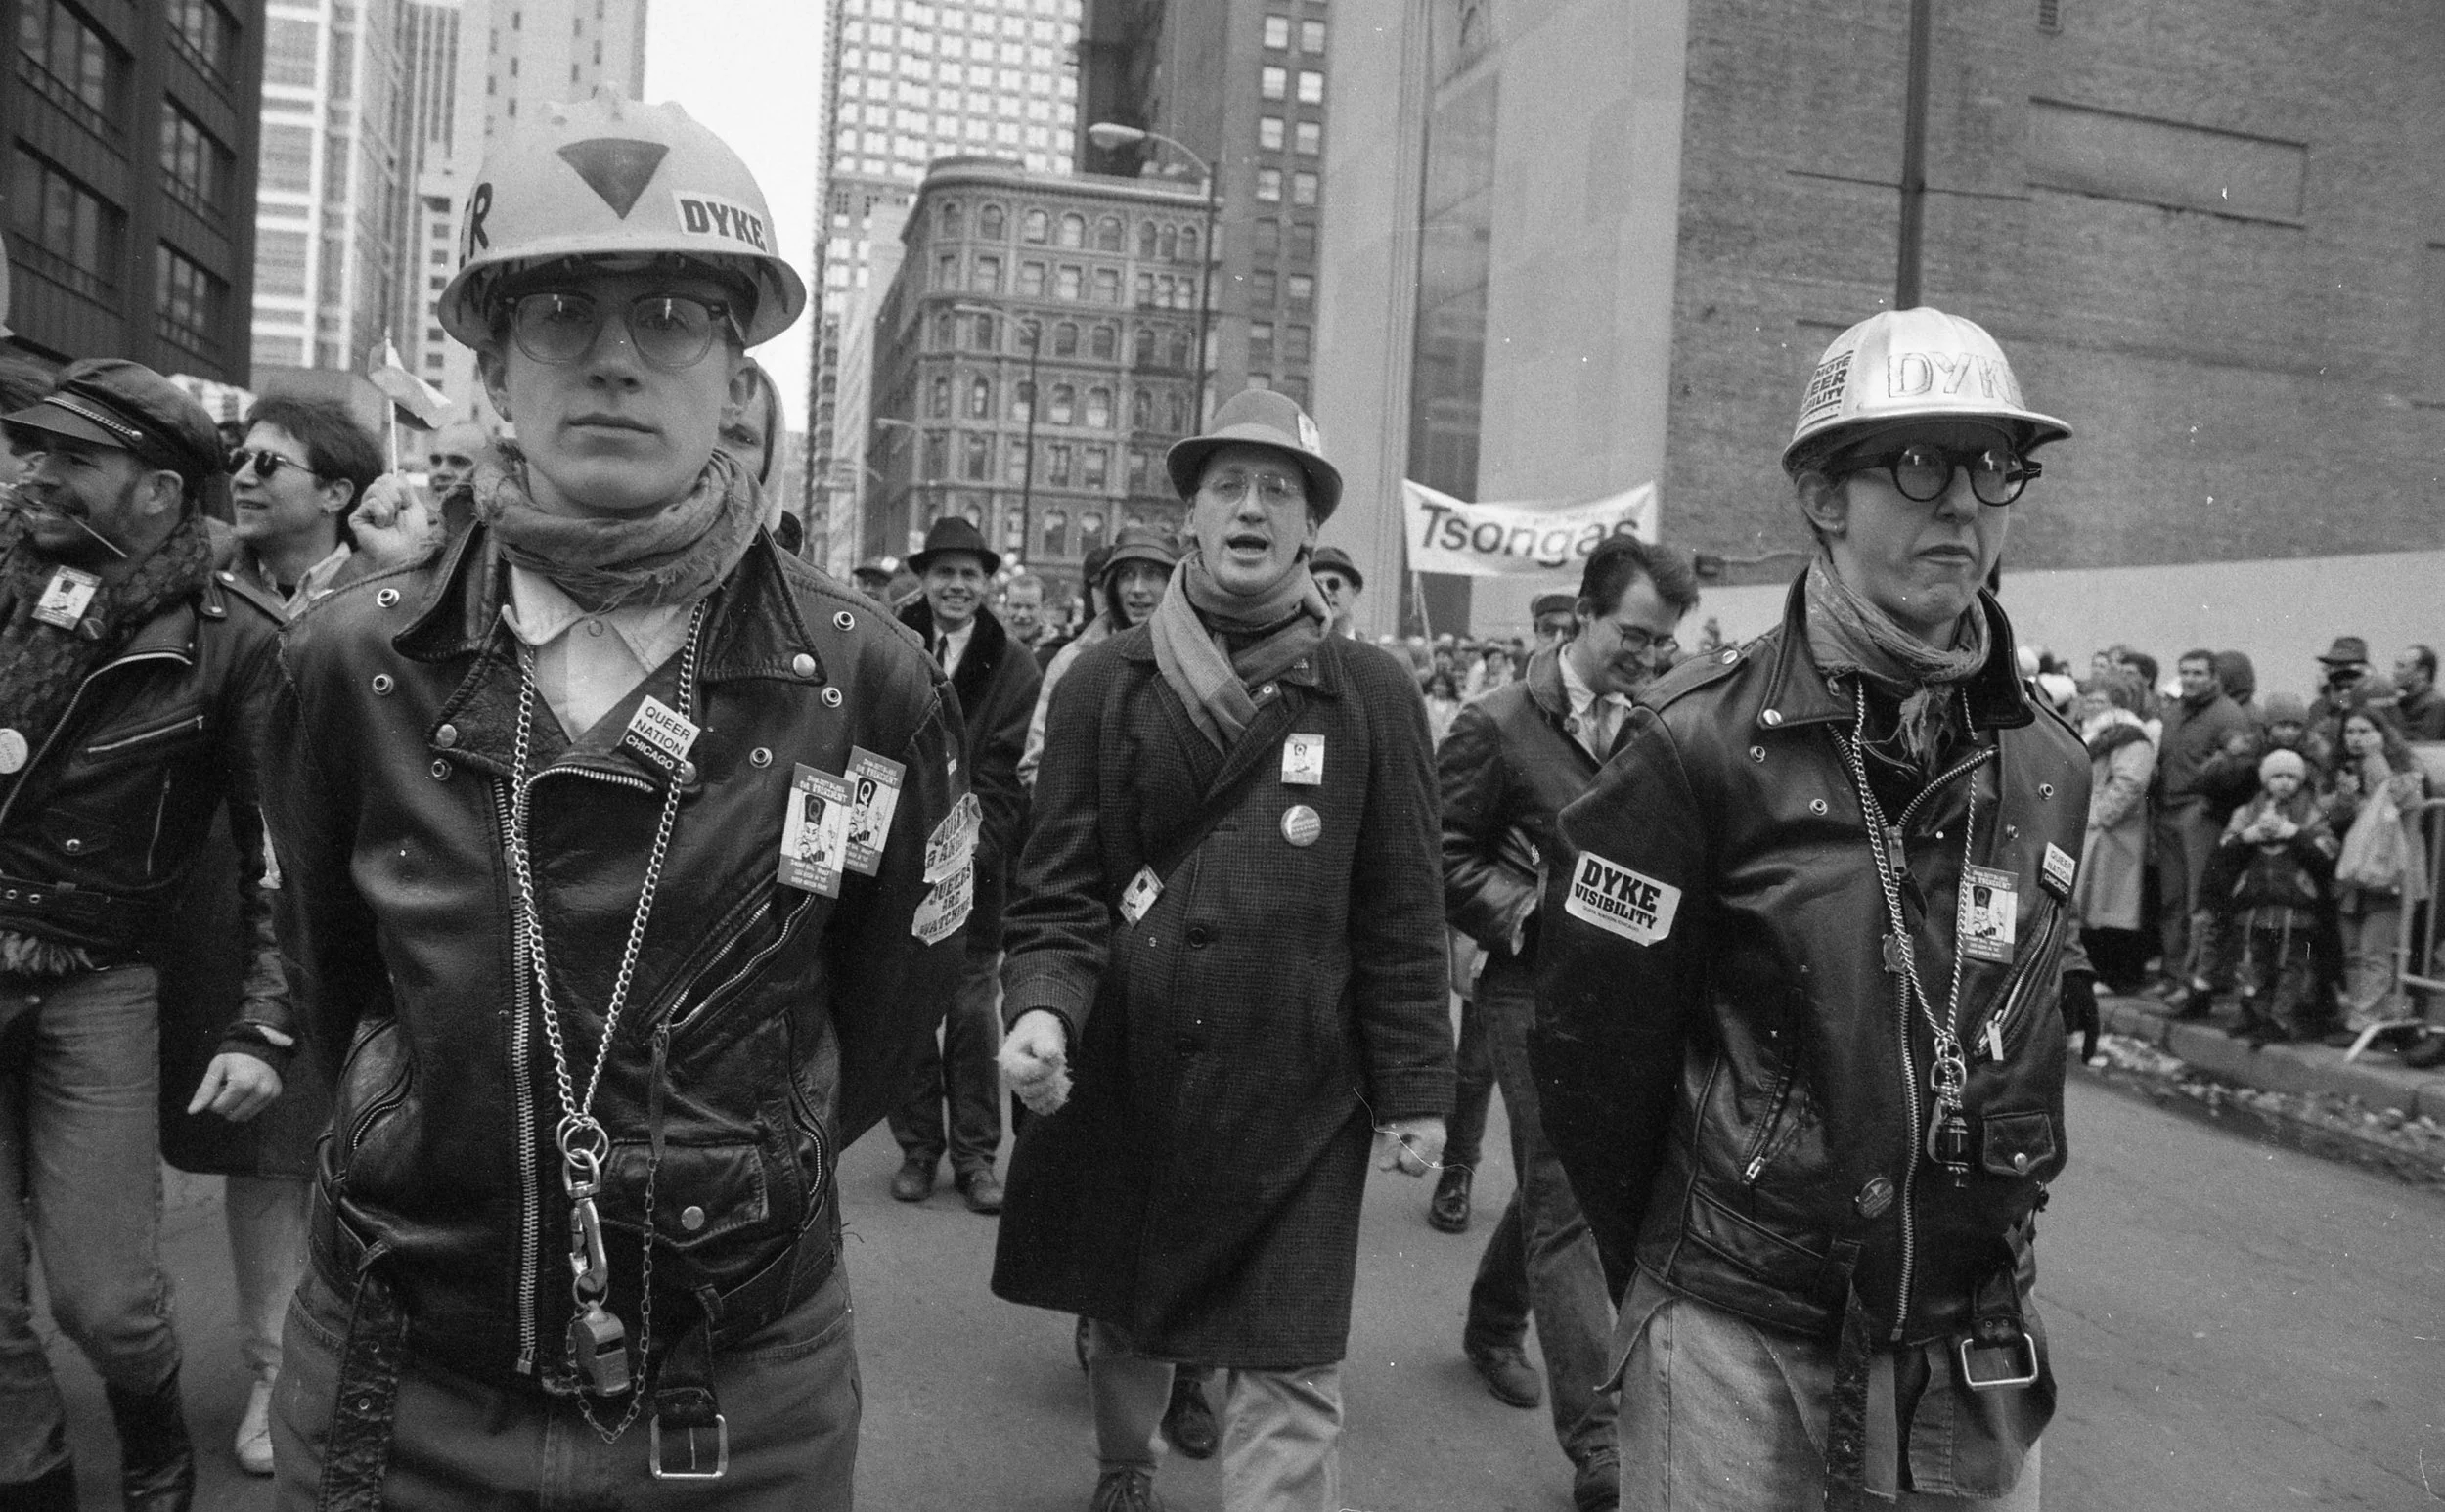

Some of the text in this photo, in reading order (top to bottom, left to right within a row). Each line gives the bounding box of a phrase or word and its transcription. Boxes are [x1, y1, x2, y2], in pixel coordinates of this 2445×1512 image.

[459, 182, 493, 271] R
[680, 198, 767, 252] DYKE
[1809, 368, 1847, 397] EER
[1813, 355, 1852, 380] MOTE
[1887, 352, 2024, 410] DYK
[1807, 385, 1845, 408] ILITY
[634, 718, 685, 756] NATION
[645, 706, 691, 740] QUEER
[625, 734, 675, 770] CHICAGO
[808, 798, 822, 823] Q
[859, 780, 872, 806] Q
[1580, 858, 1662, 913] DYKE
[1976, 888, 1988, 907] Q
[1575, 882, 1658, 930] VISIBILITY
